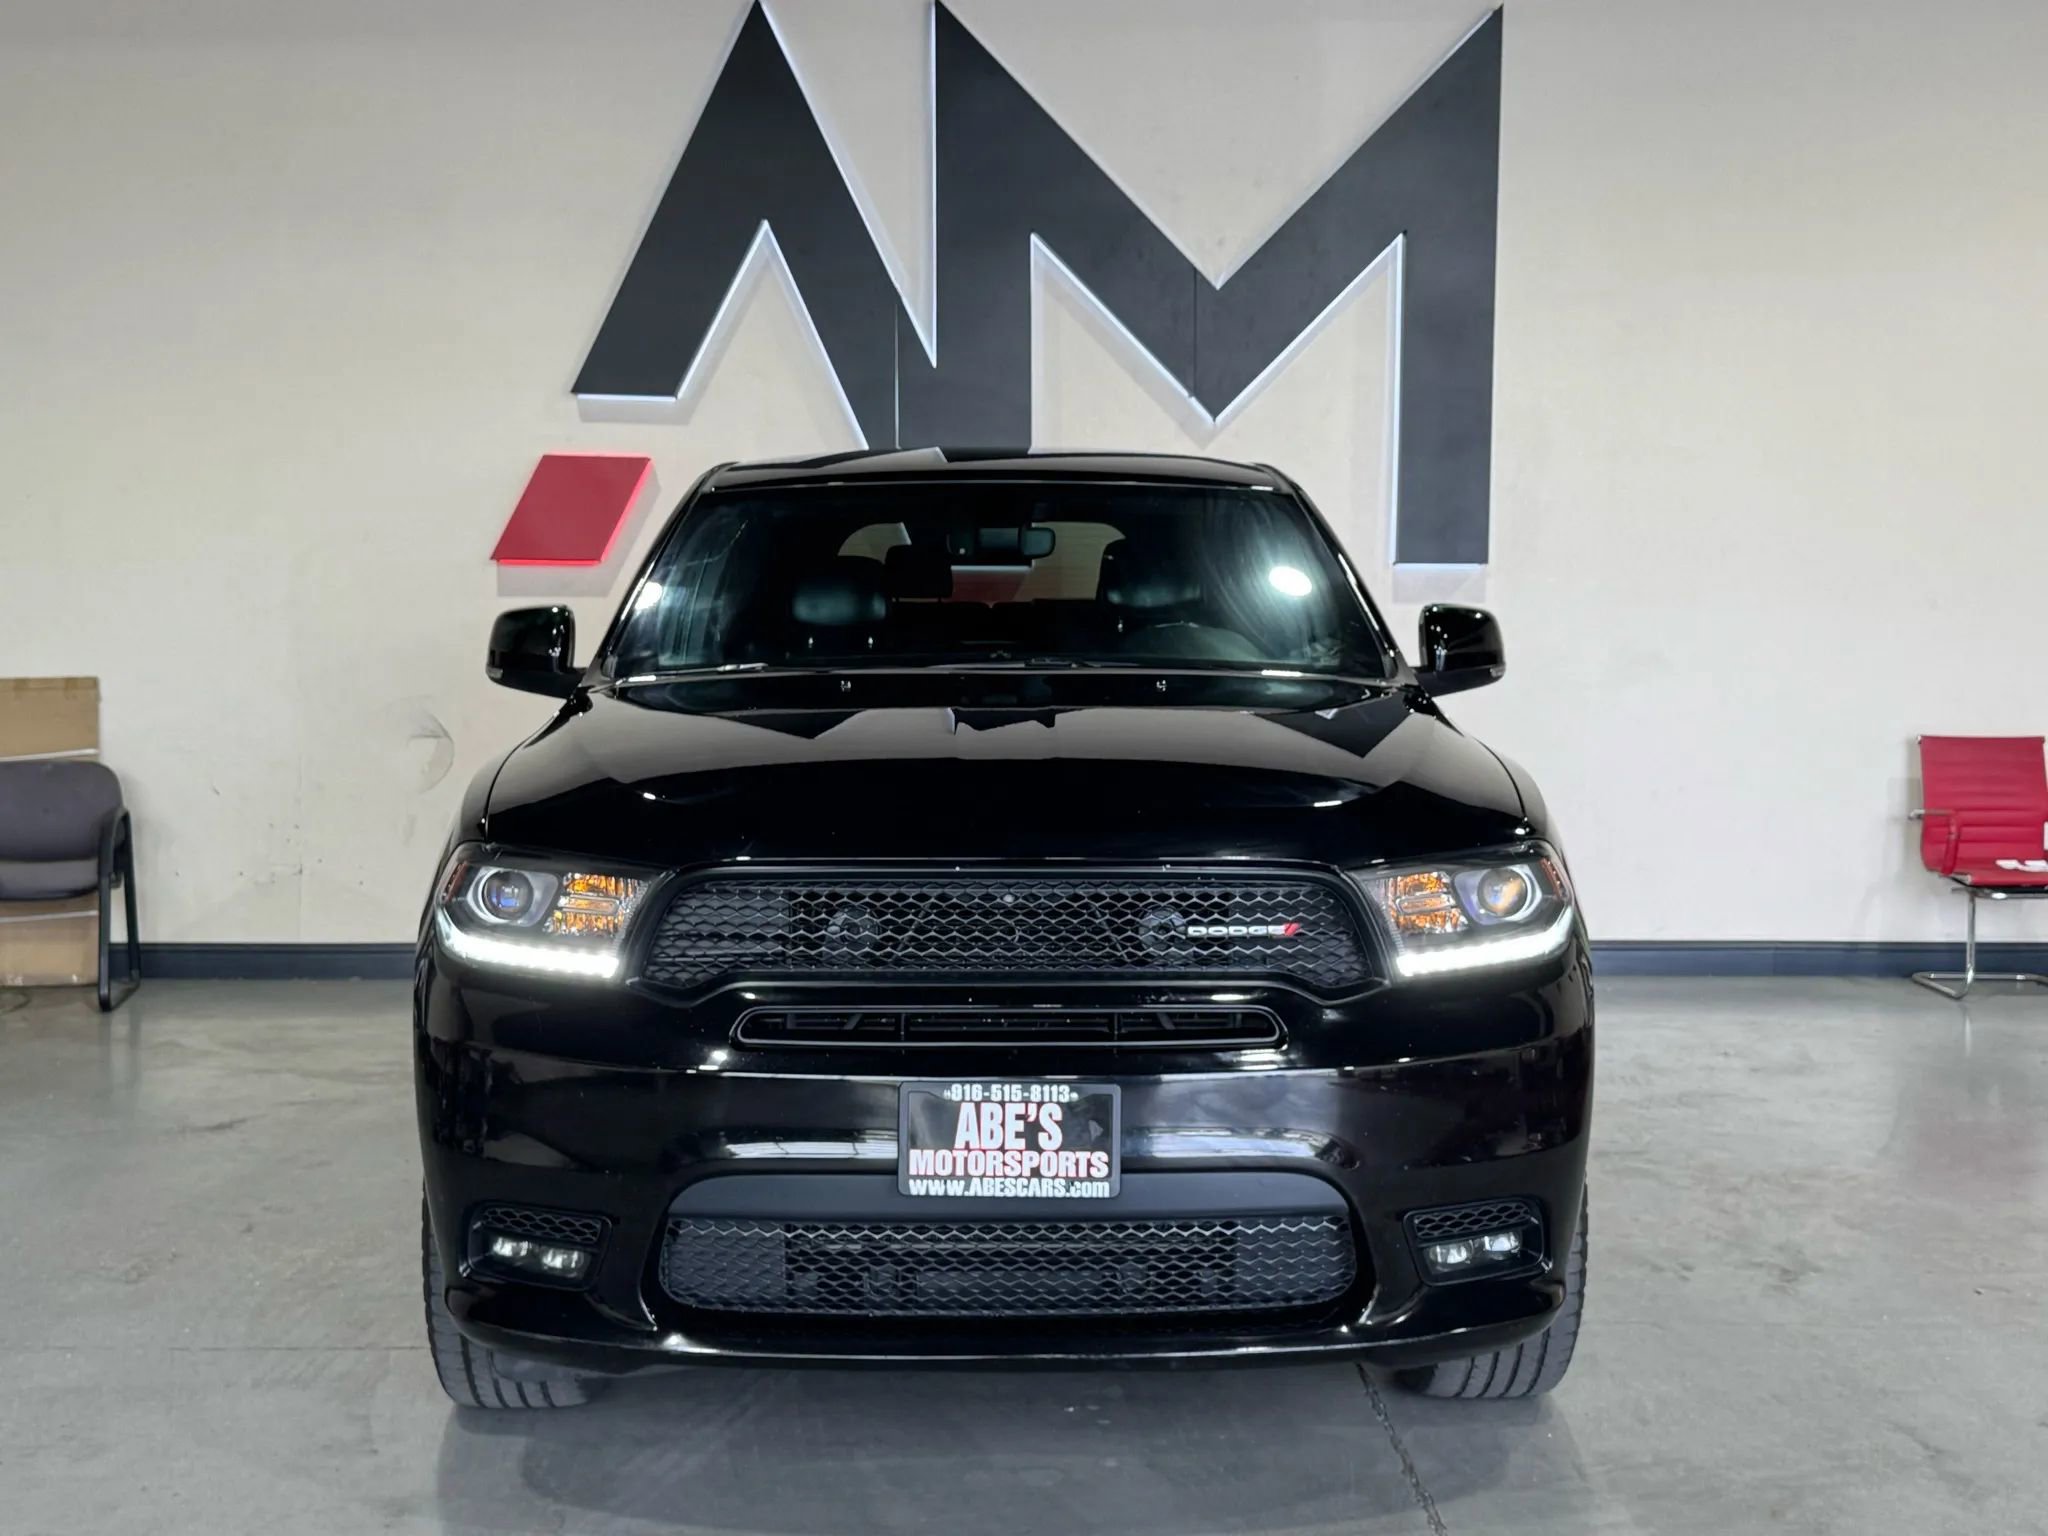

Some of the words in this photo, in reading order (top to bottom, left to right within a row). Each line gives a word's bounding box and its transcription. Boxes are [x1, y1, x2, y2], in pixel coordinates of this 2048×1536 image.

[1187, 925, 1286, 937] DODGE
[953, 1102, 1063, 1151] ABE'S
[908, 1149, 1110, 1178] MOTORSPORTS
[908, 1178, 1111, 1198] www.ABESCARS.com
